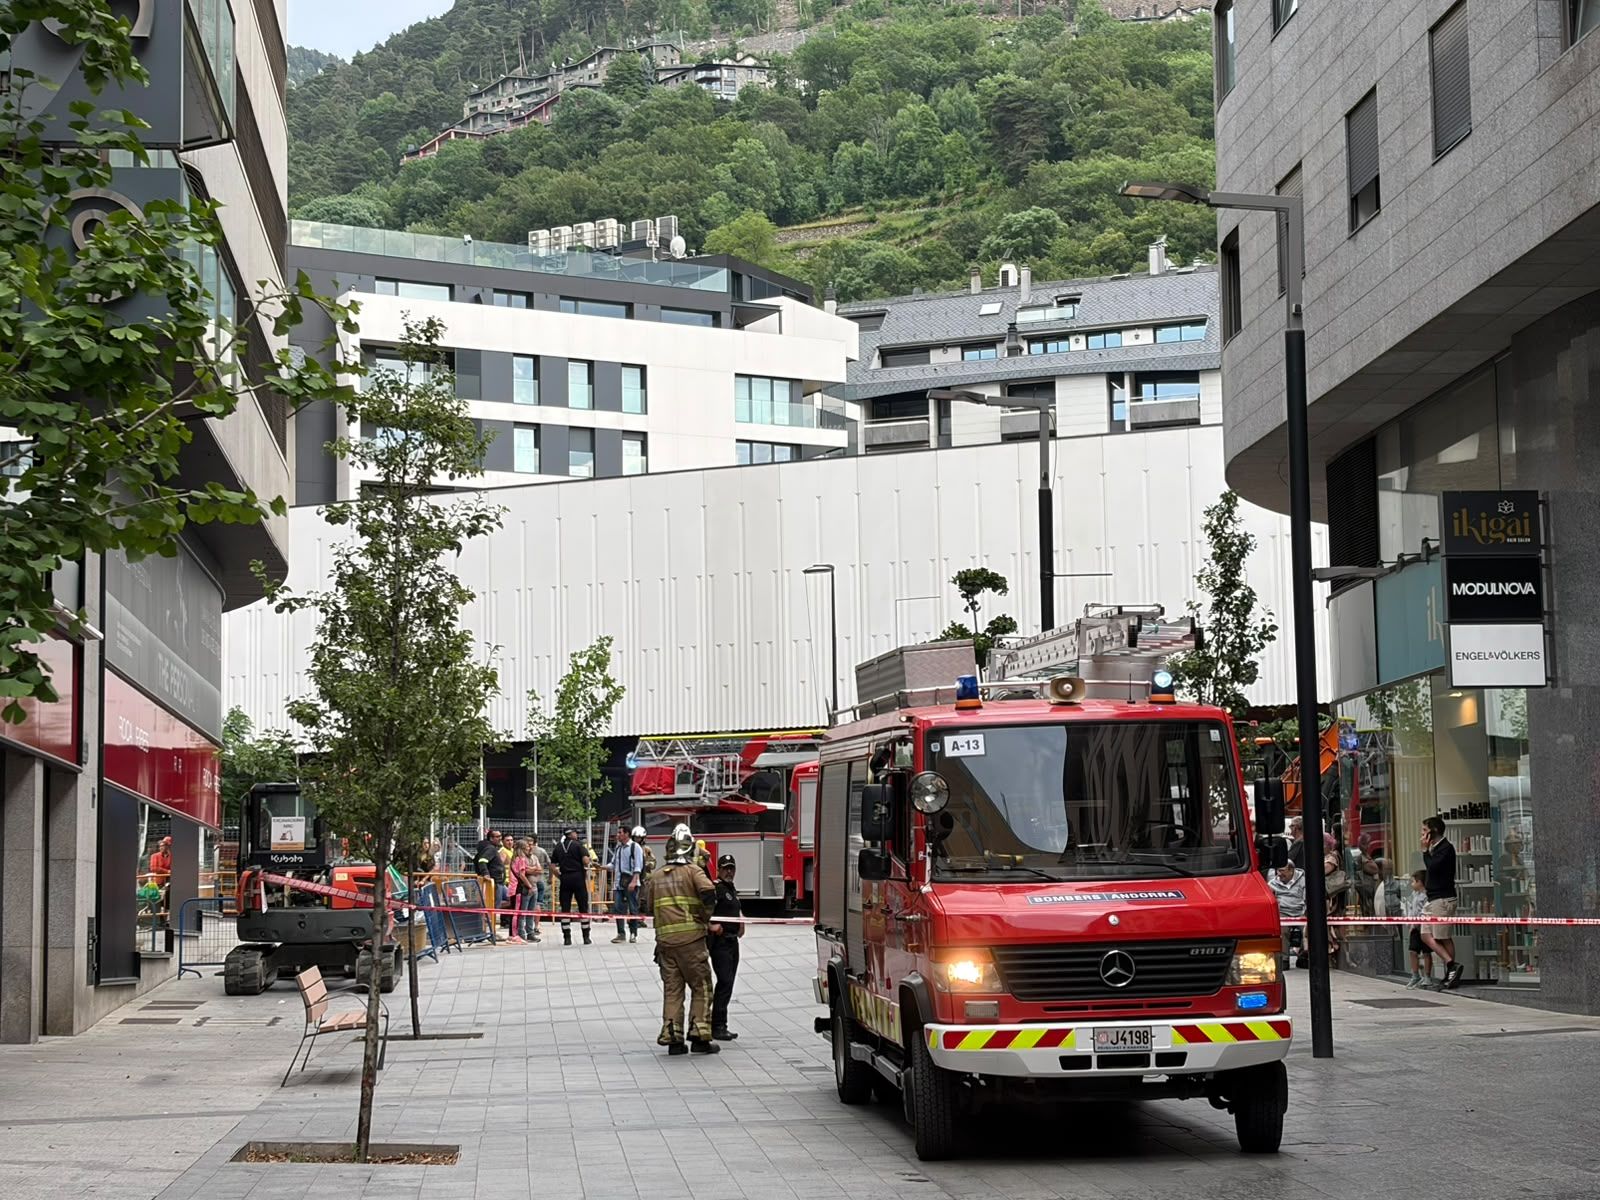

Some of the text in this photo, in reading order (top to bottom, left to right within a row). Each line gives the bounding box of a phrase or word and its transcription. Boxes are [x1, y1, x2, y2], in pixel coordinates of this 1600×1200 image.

[1452, 507, 1531, 544] ikigai
[1452, 582, 1536, 595] MODULNOVA
[1455, 650, 1541, 661] ENGEL&VÖLKERS
[952, 739, 980, 751] A-13
[270, 854, 303, 863] Kubota
[1033, 891, 1177, 903] BOMBERS ANDORRA
[1110, 1030, 1149, 1045] J4198
